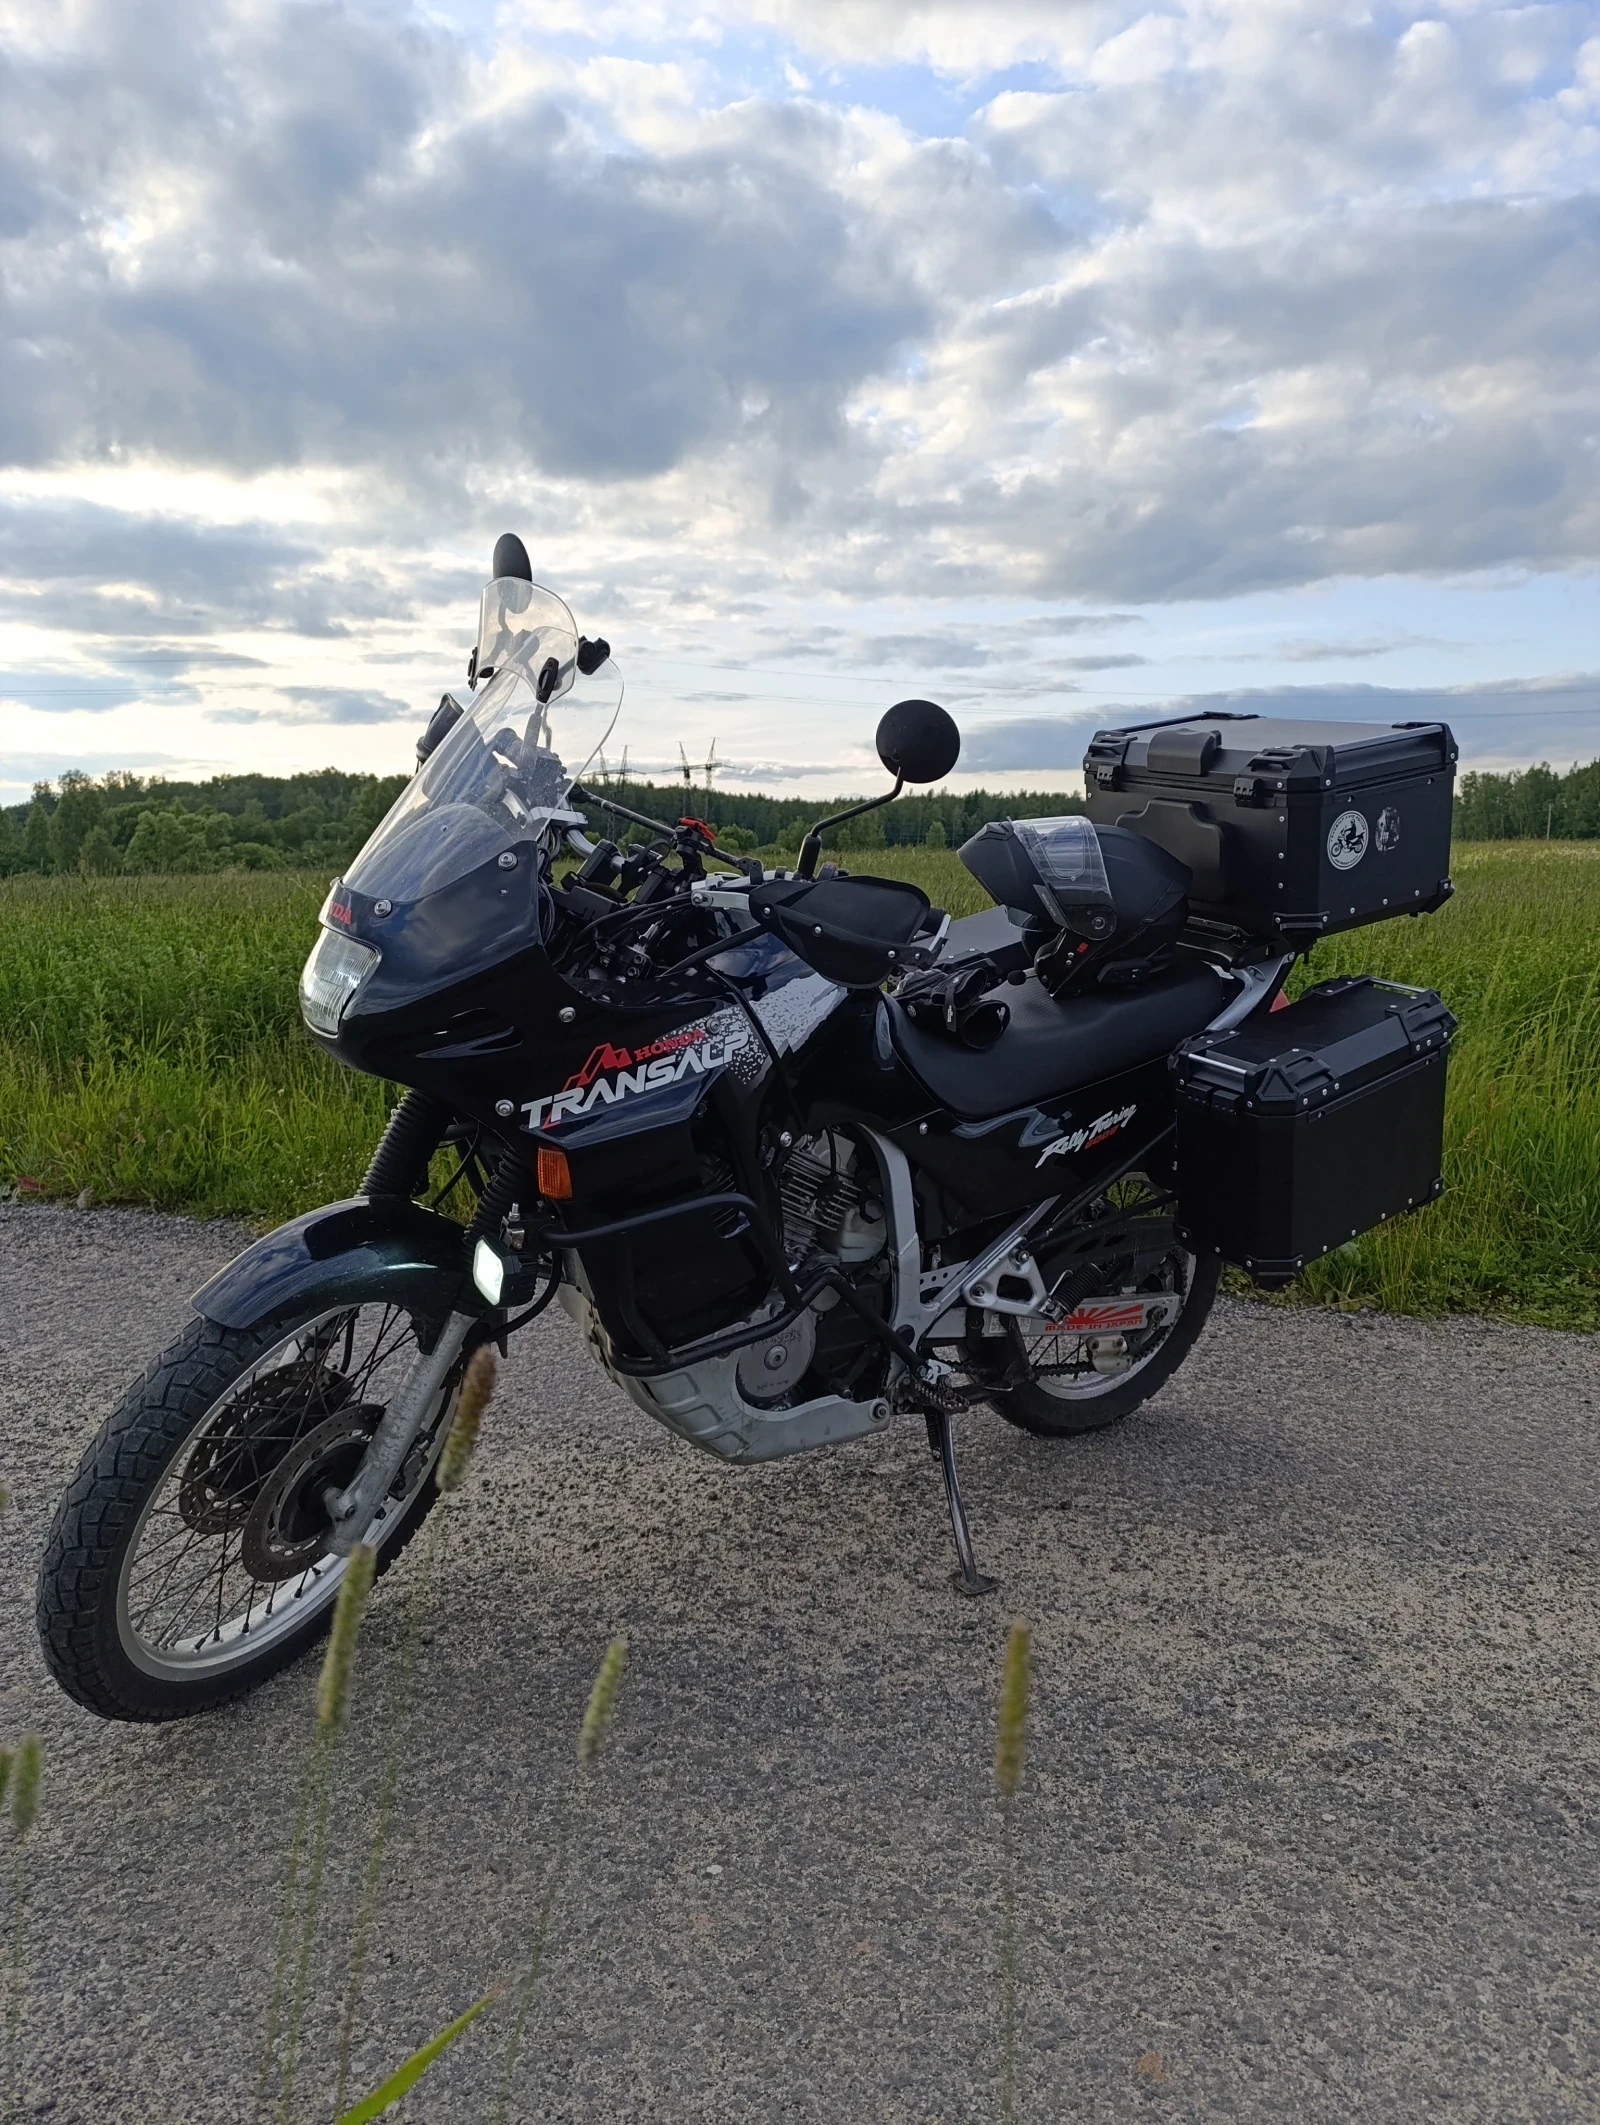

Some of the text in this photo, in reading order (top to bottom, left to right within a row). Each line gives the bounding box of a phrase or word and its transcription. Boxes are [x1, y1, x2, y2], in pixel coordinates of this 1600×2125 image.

[634, 1028, 706, 1061] HONDA
[520, 1032, 749, 1130] TRANSALP
[1034, 1104, 1137, 1168] Rally Touring
[1045, 1324, 1083, 1332] MADE
[1106, 1319, 1142, 1329] JAPAN
